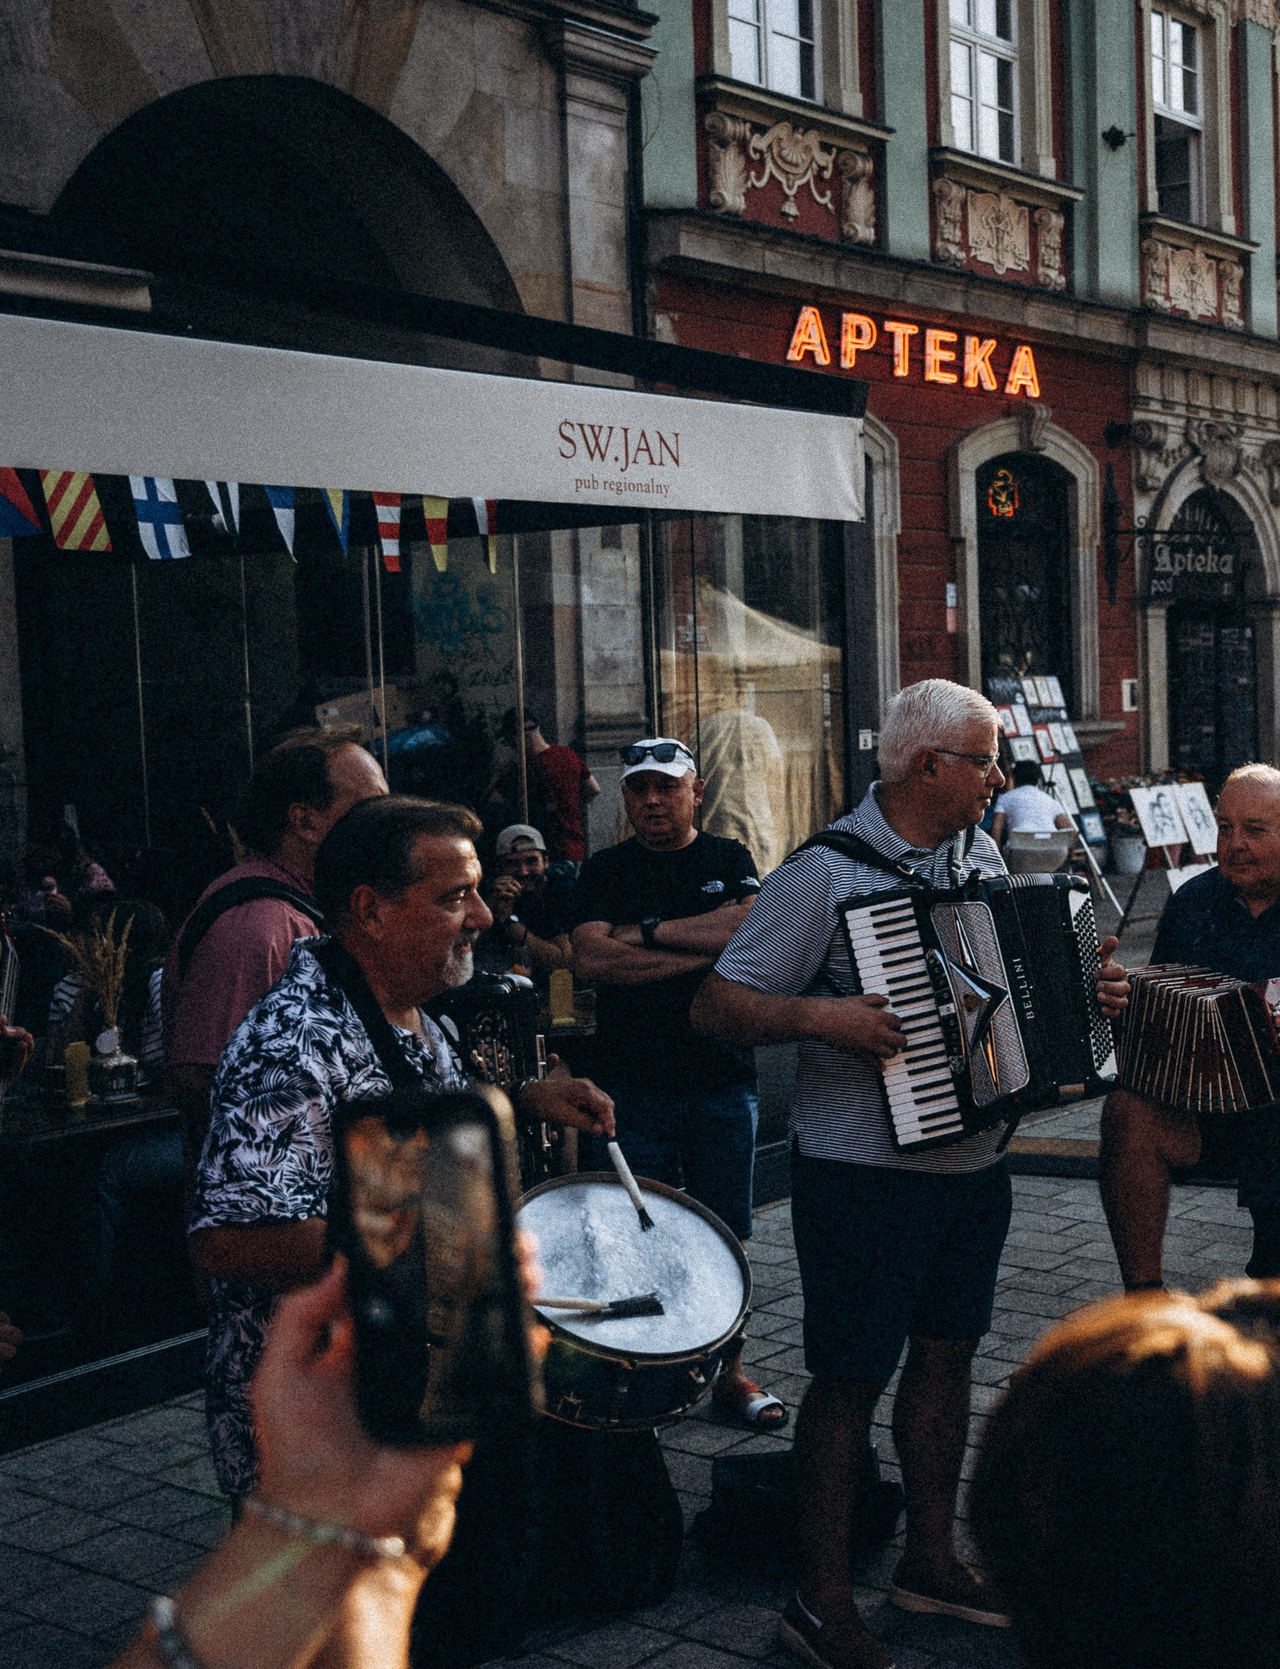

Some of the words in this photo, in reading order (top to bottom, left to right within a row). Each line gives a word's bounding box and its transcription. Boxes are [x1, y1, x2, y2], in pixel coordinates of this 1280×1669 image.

[786, 305, 1040, 398] APTEKA
[575, 474, 599, 492] pub
[603, 477, 670, 498] regionalny
[1153, 543, 1234, 576] Apteka
[1012, 957, 1035, 1020] BELLINI
